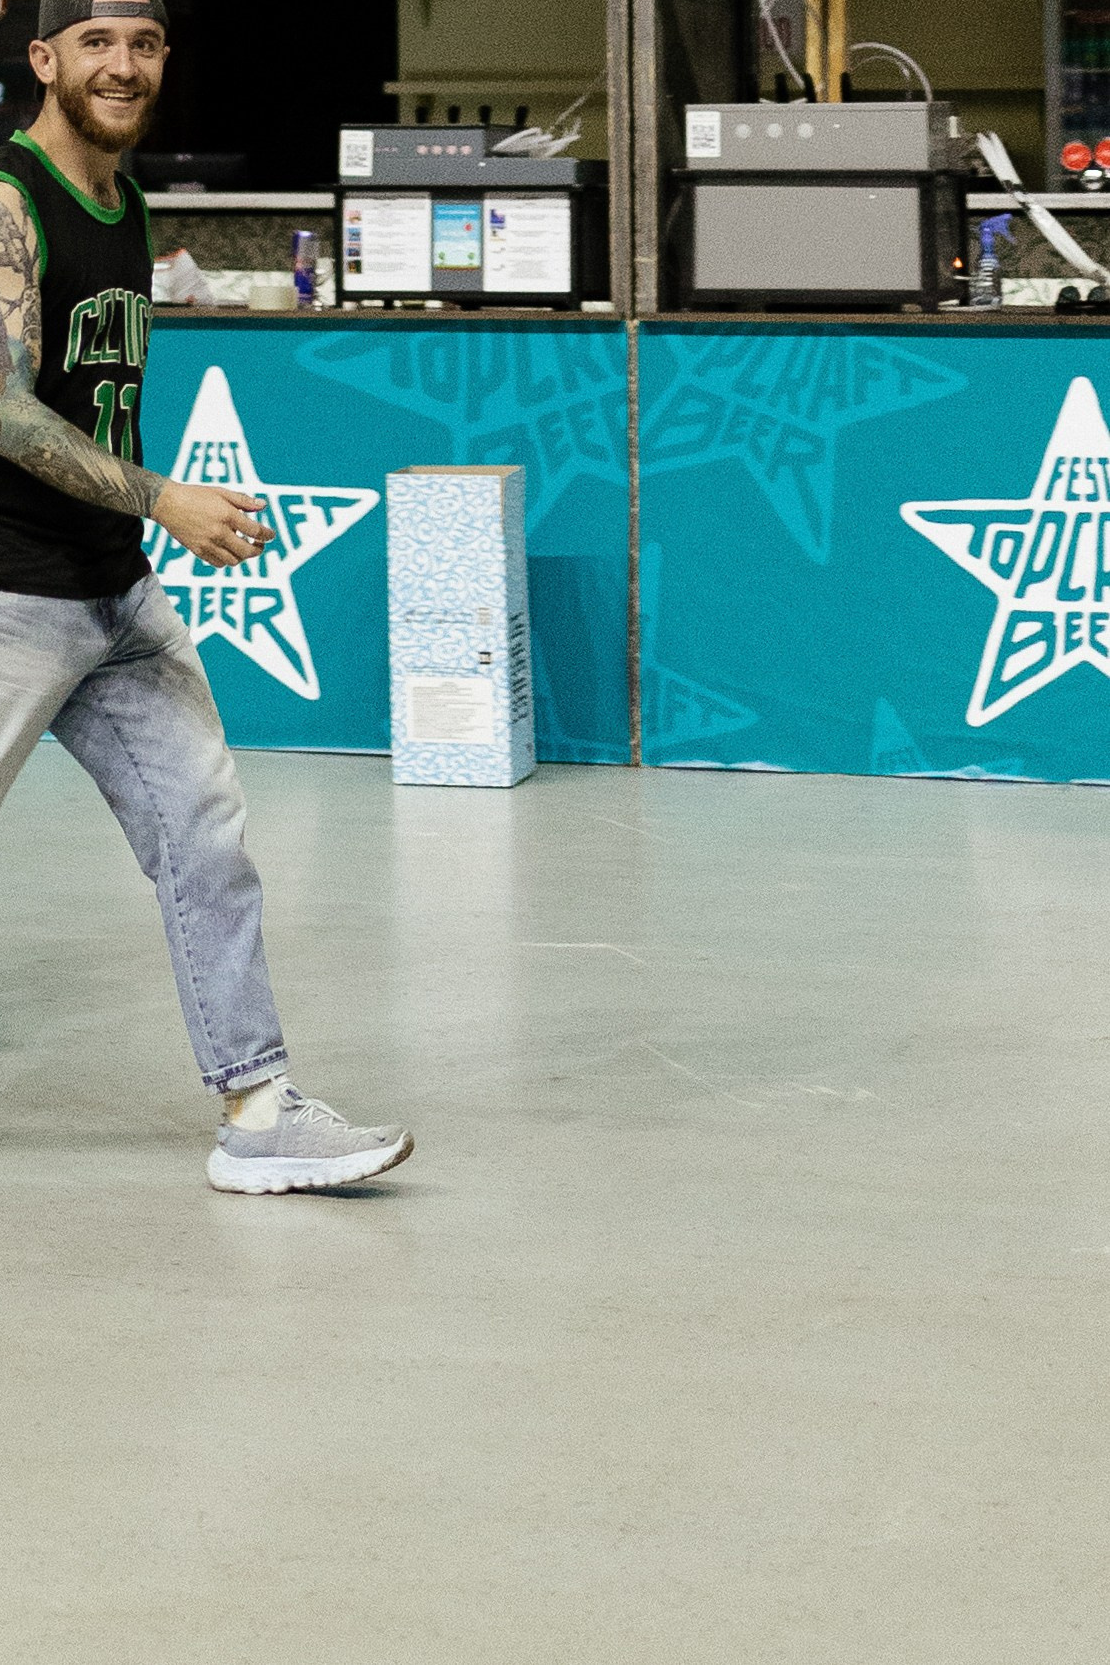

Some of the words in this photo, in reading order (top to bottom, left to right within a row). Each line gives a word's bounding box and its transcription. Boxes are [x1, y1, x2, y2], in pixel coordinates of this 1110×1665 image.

[93, 380, 139, 462] 11
[182, 441, 244, 484] FEST
[1044, 456, 1110, 502] FEST
